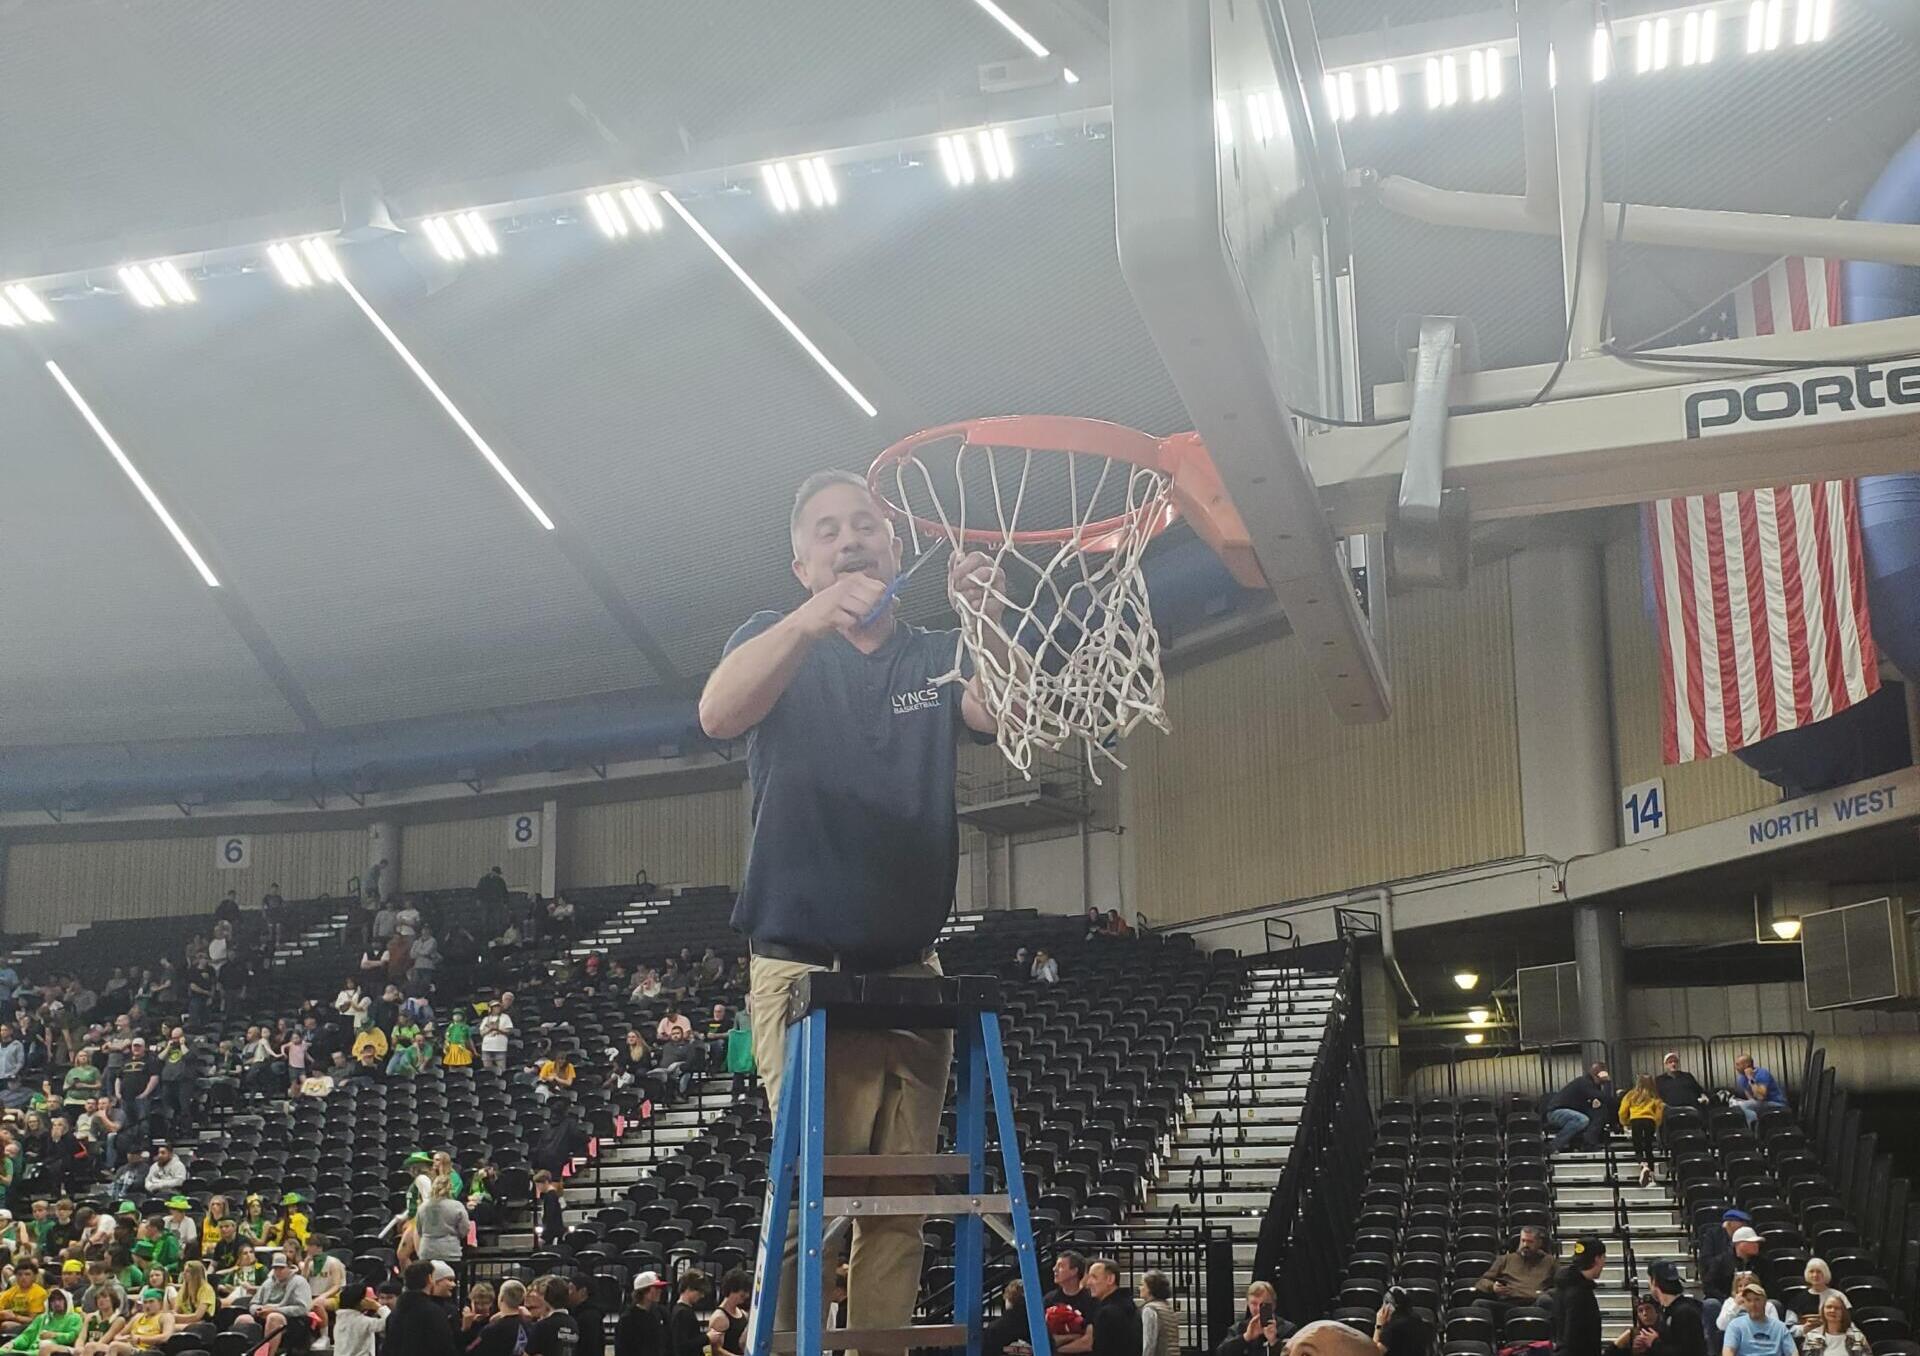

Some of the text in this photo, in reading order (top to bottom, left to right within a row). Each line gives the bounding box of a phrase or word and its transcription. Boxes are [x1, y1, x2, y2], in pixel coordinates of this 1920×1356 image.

[891, 687, 938, 707] LYNCS
[893, 700, 942, 714] BASKETBALL
[1625, 787, 1663, 834] 14
[1750, 786, 1897, 844] NORTH WEST
[514, 816, 533, 842] 8
[224, 838, 243, 863] 6
